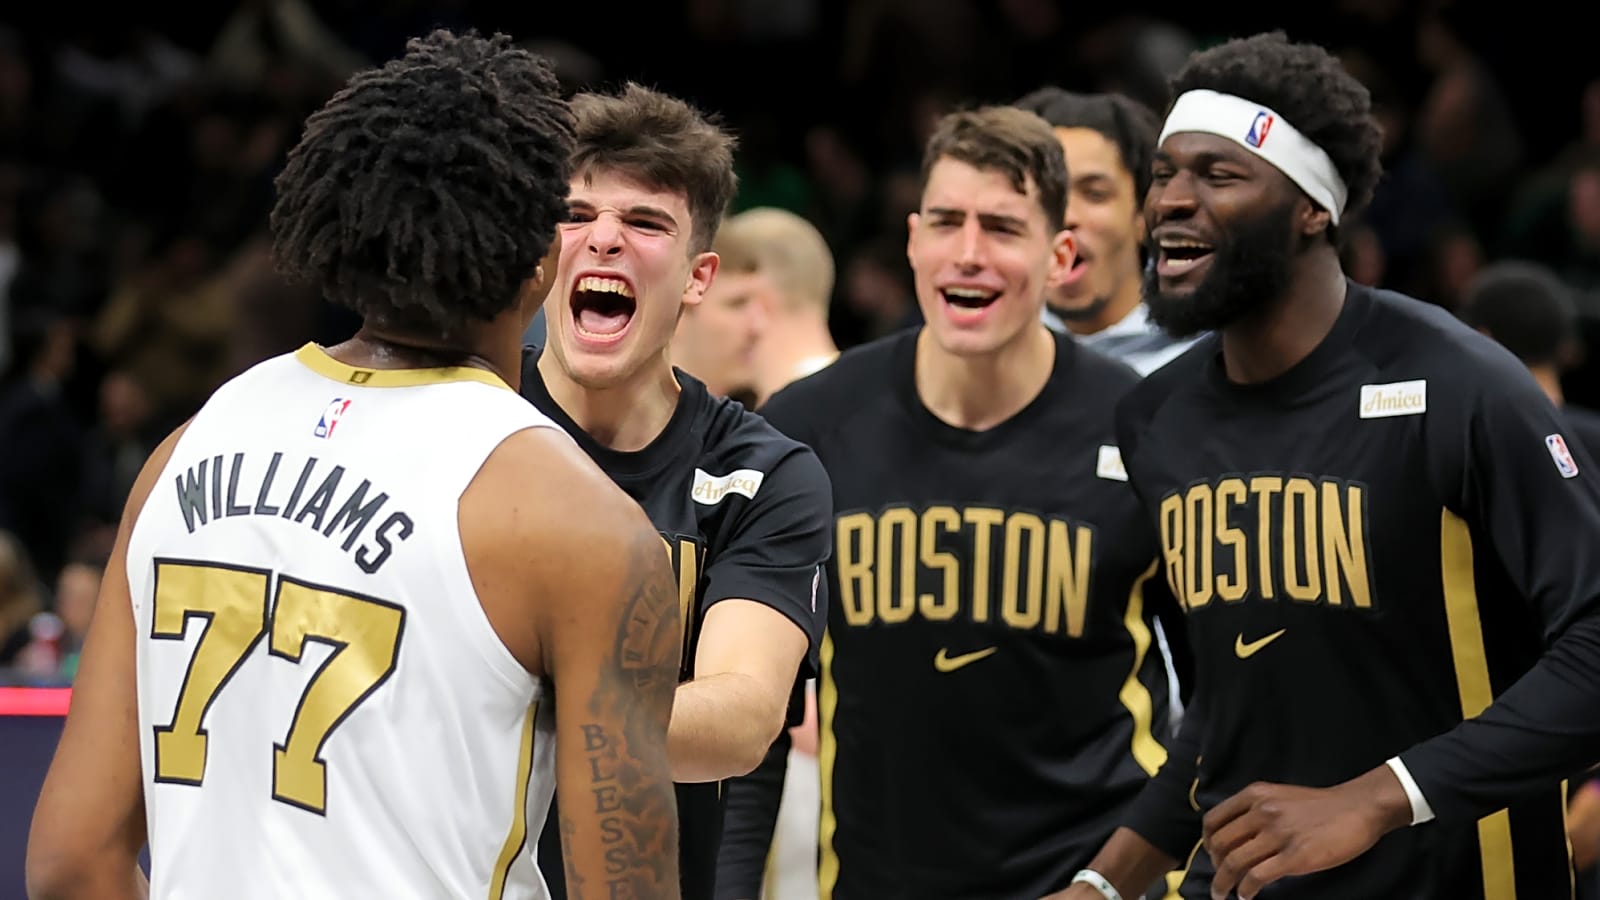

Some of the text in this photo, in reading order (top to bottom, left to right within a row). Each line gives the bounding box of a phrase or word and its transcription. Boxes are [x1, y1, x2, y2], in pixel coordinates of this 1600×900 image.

[1364, 389, 1423, 413] Amica
[175, 452, 414, 574] WILLIAMS
[837, 506, 1091, 637] BOSTON
[1160, 476, 1371, 614] BOSTON
[150, 556, 406, 816] 77
